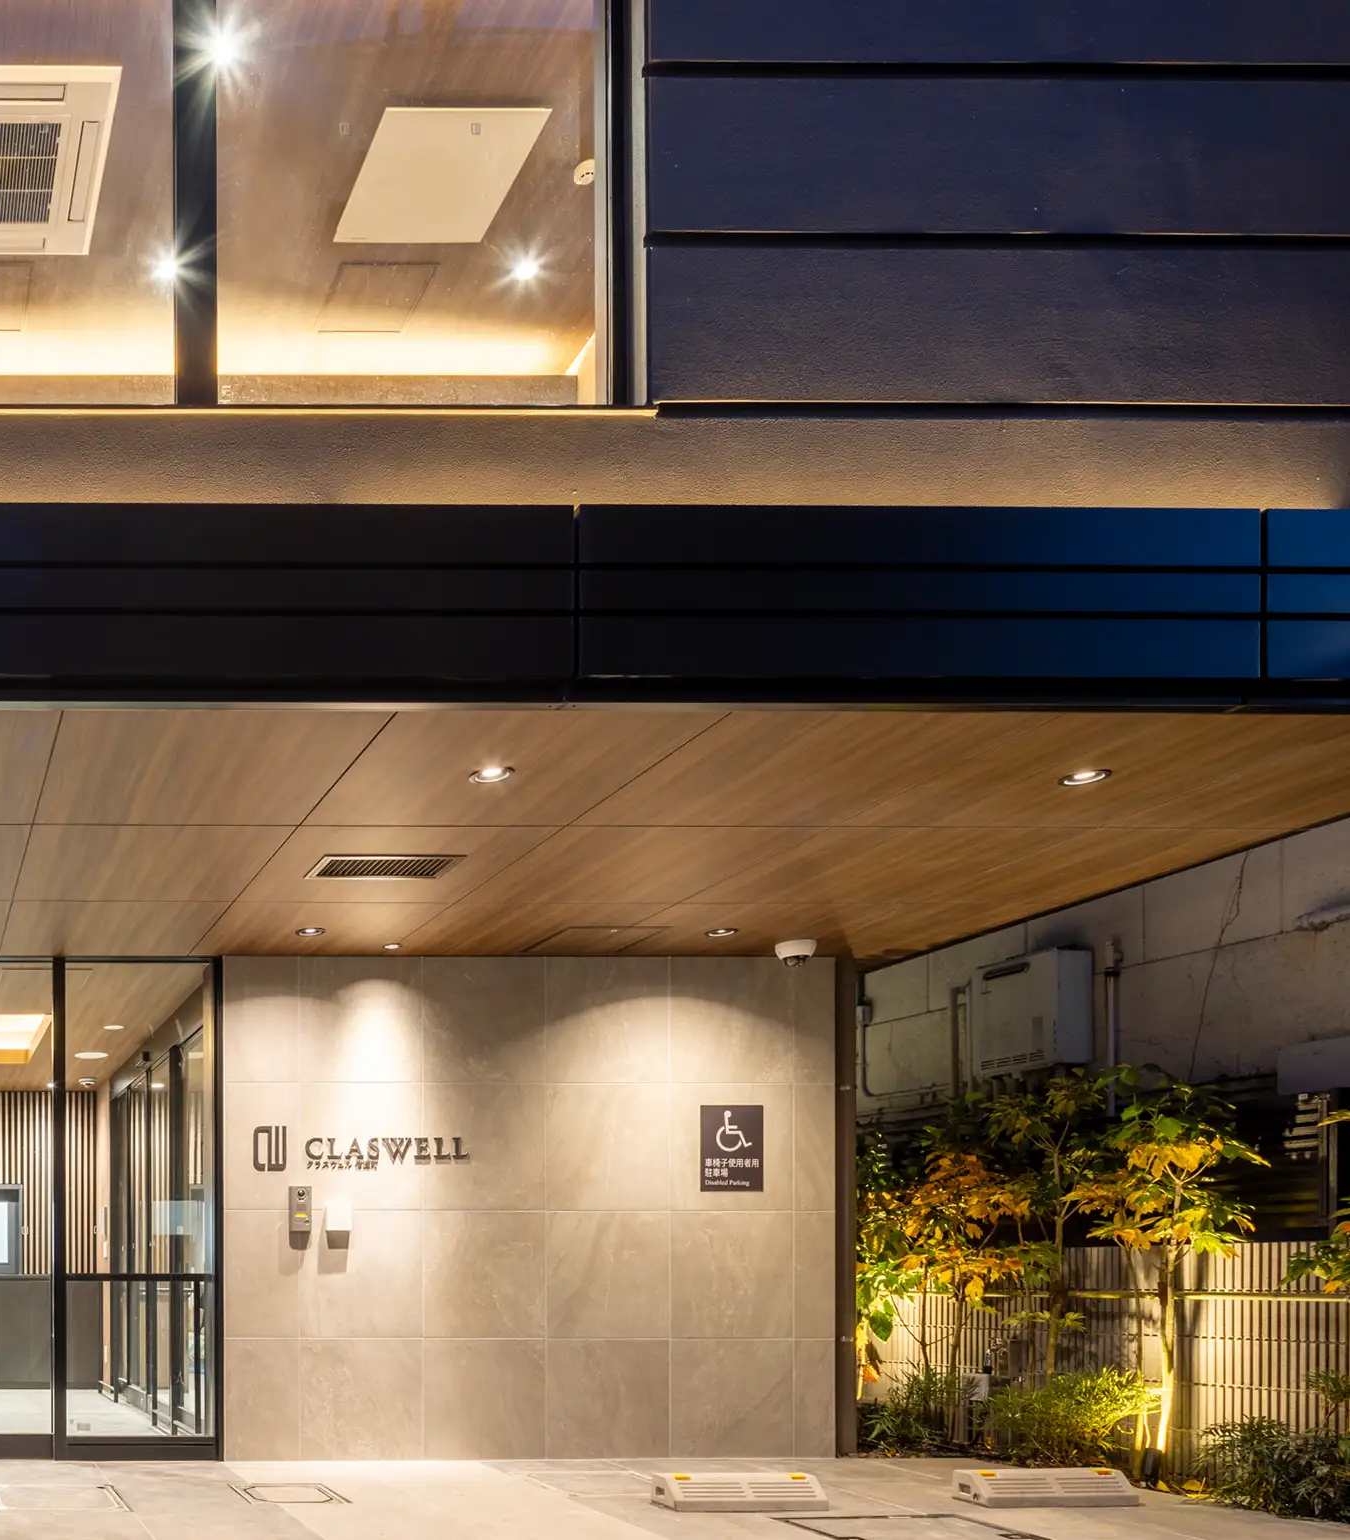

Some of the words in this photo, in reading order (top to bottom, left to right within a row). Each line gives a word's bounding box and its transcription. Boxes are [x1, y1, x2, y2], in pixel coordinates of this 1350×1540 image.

[305, 1137, 470, 1163] CLASWELL
[705, 1158, 759, 1168] 車椅子使用者用
[705, 1168, 729, 1177] 駐車場
